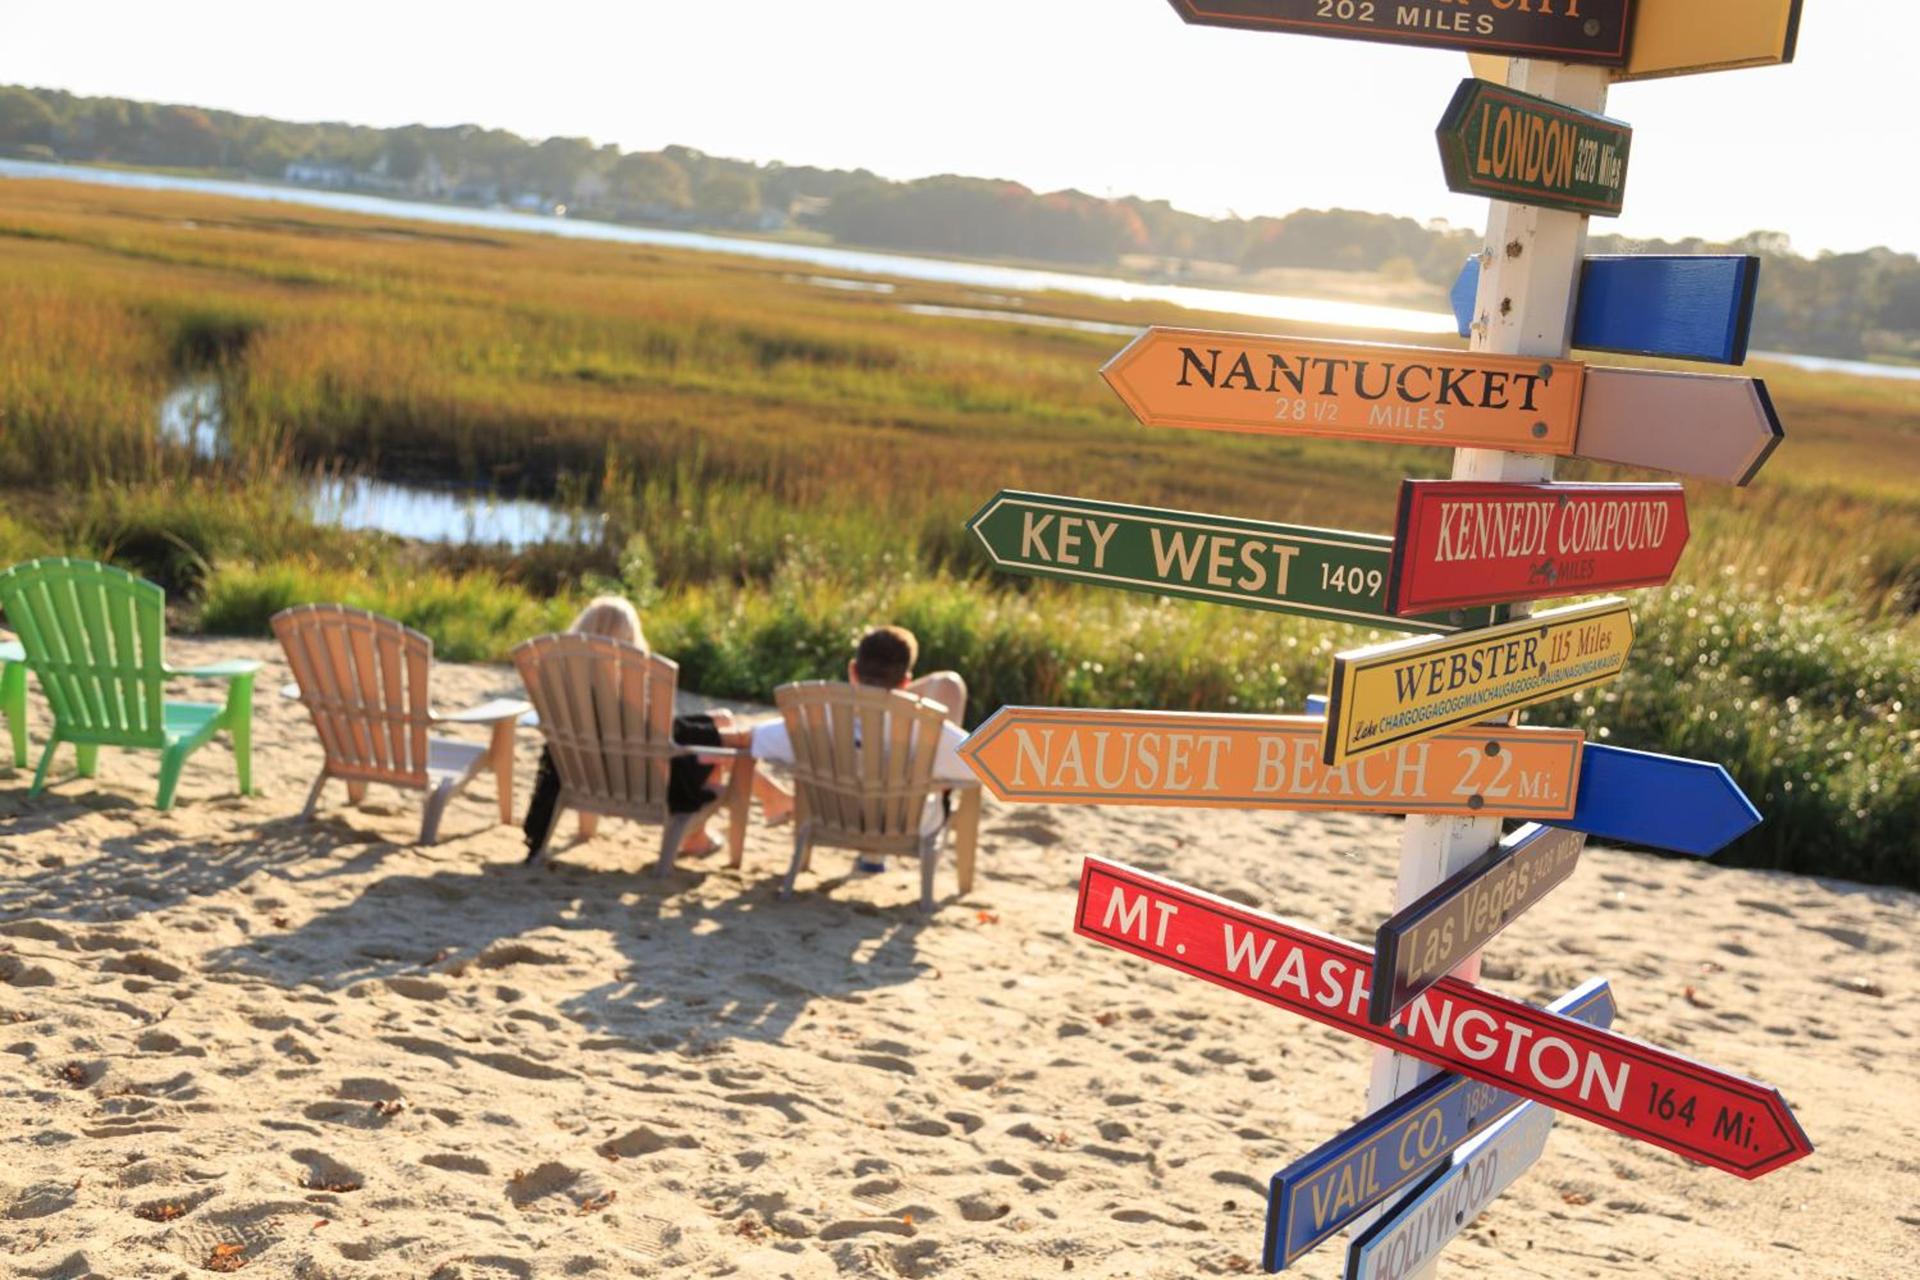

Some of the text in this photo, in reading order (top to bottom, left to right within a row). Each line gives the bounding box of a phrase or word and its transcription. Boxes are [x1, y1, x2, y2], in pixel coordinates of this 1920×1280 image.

[1316, 0, 1375, 22] 202
[1396, 6, 1495, 34] MILES
[1476, 103, 1578, 189] LONDON
[1598, 144, 1622, 189] Miles
[1176, 346, 1549, 411] NANTUCKET
[1274, 397, 1307, 421] 28
[1368, 404, 1446, 431] MILES
[1020, 511, 1383, 598] KEY WEST 1409
[1434, 501, 1669, 562] KENNEDY COMPOUND
[1557, 559, 1596, 580] MILES
[1549, 631, 1571, 665] 115
[1575, 623, 1613, 658] Miles
[1010, 728, 1232, 791] NAUSET
[1451, 748, 1514, 798] 22
[1517, 770, 1560, 800] Mi.
[1352, 720, 1378, 743] Lake
[1406, 917, 1454, 989] Las
[1463, 861, 1530, 943] Vegas
[1102, 886, 1759, 1153] MT. WASHNGTON 164 Mi.
[1311, 1147, 1380, 1231] VAIL
[1399, 1108, 1448, 1171] CO.
